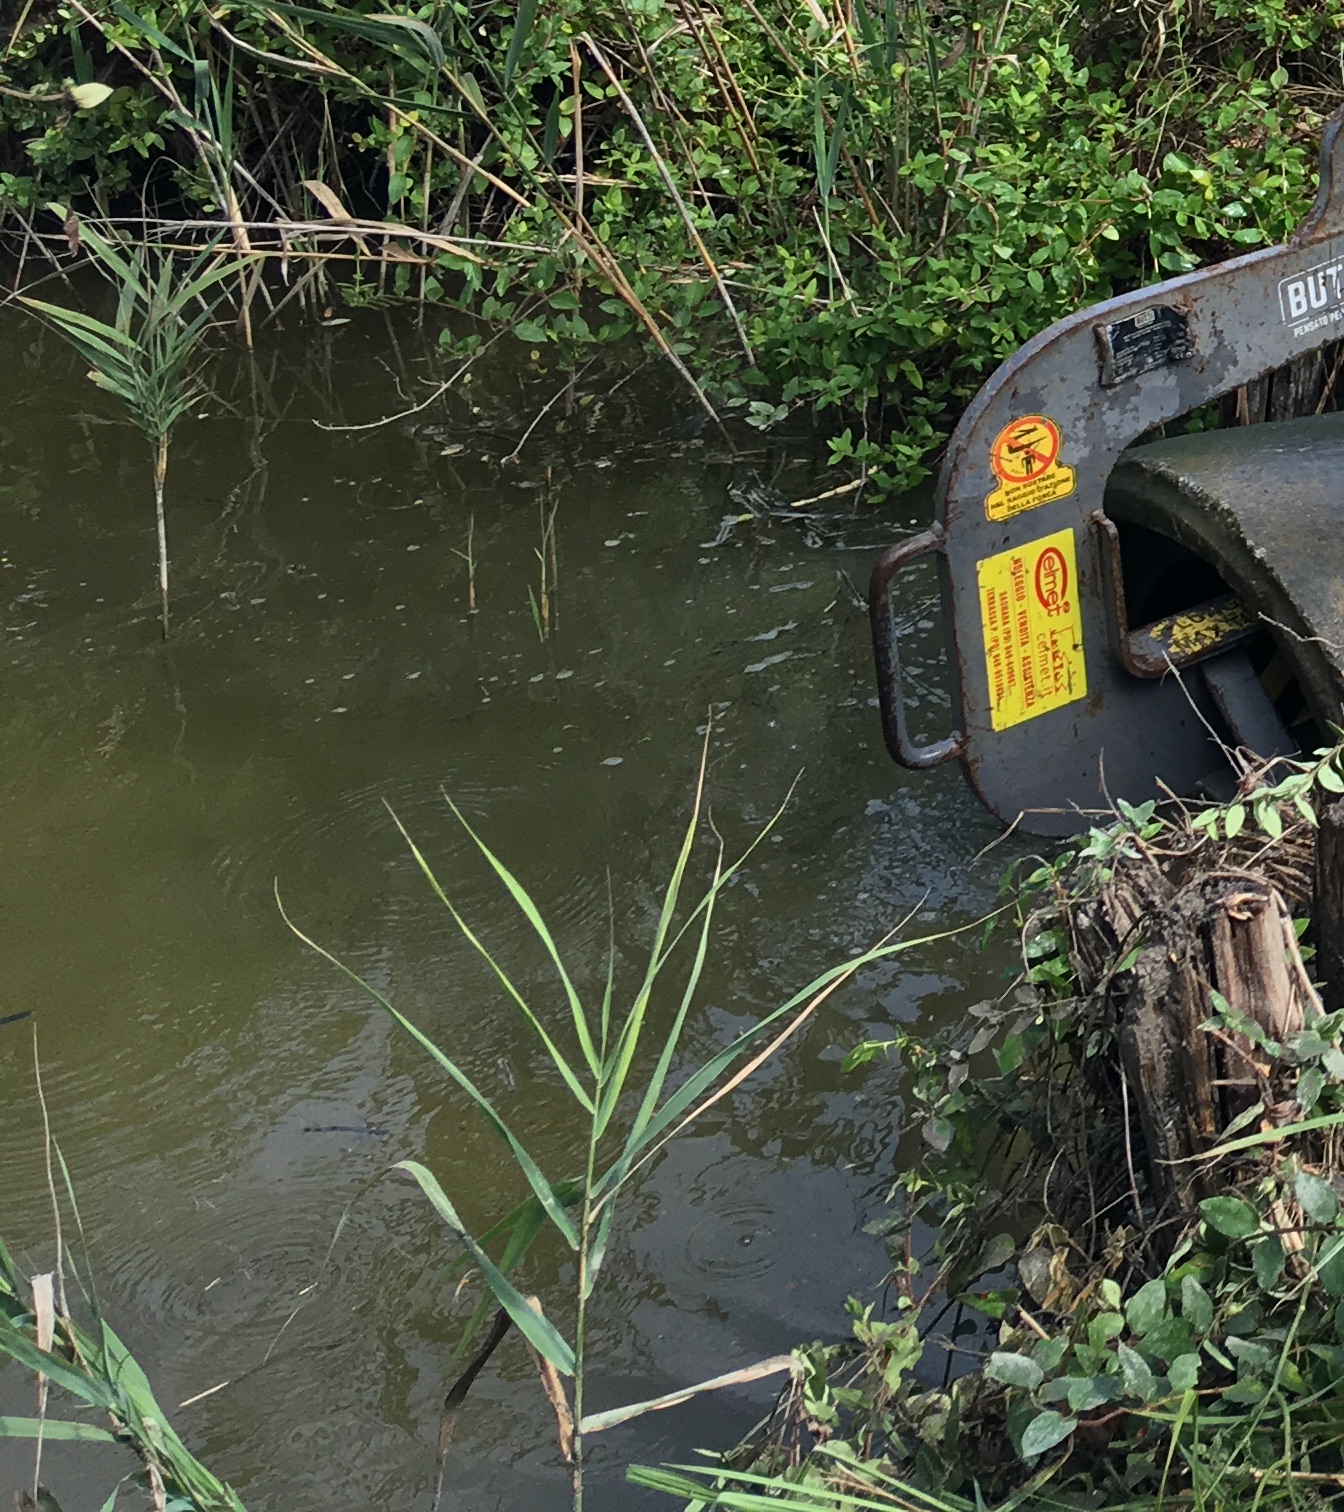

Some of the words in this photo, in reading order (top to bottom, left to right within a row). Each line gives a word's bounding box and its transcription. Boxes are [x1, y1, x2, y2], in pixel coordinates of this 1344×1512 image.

[1294, 316, 1328, 337] PENSATO
[1007, 499, 1030, 512] DELLA
[1013, 557, 1026, 602] NOLEGGIO
[1035, 546, 1069, 617] Celmet
[1018, 609, 1029, 647] VENDITA
[1021, 655, 1035, 708] ASSISTENZA
[1036, 632, 1053, 698] celmet.it
